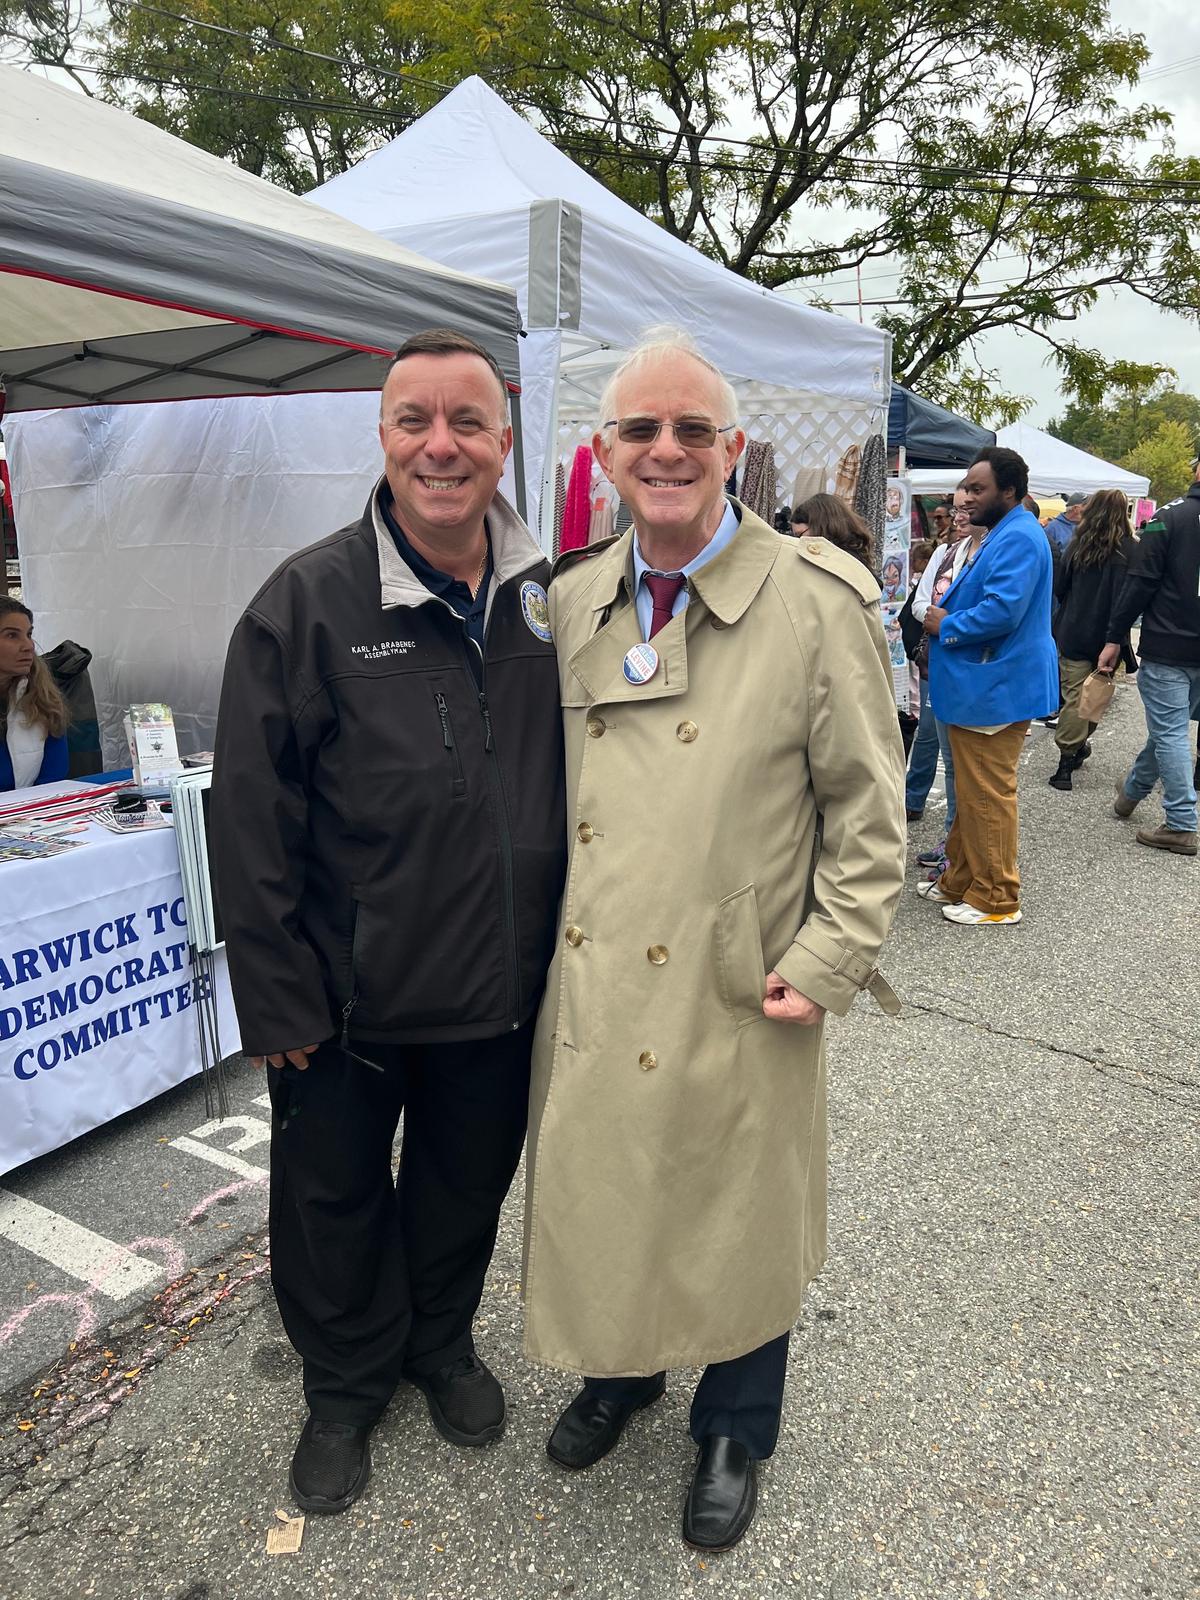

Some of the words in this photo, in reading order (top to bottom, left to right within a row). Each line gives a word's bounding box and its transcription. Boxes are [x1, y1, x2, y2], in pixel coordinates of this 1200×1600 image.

[351, 645, 370, 654] KARL
[372, 644, 379, 652] A.
[380, 640, 416, 650] BRABENEC
[364, 648, 407, 659] ASSEMBLYMAN
[630, 650, 651, 676] LEVINE
[13, 973, 211, 1081] COMMITTEE
